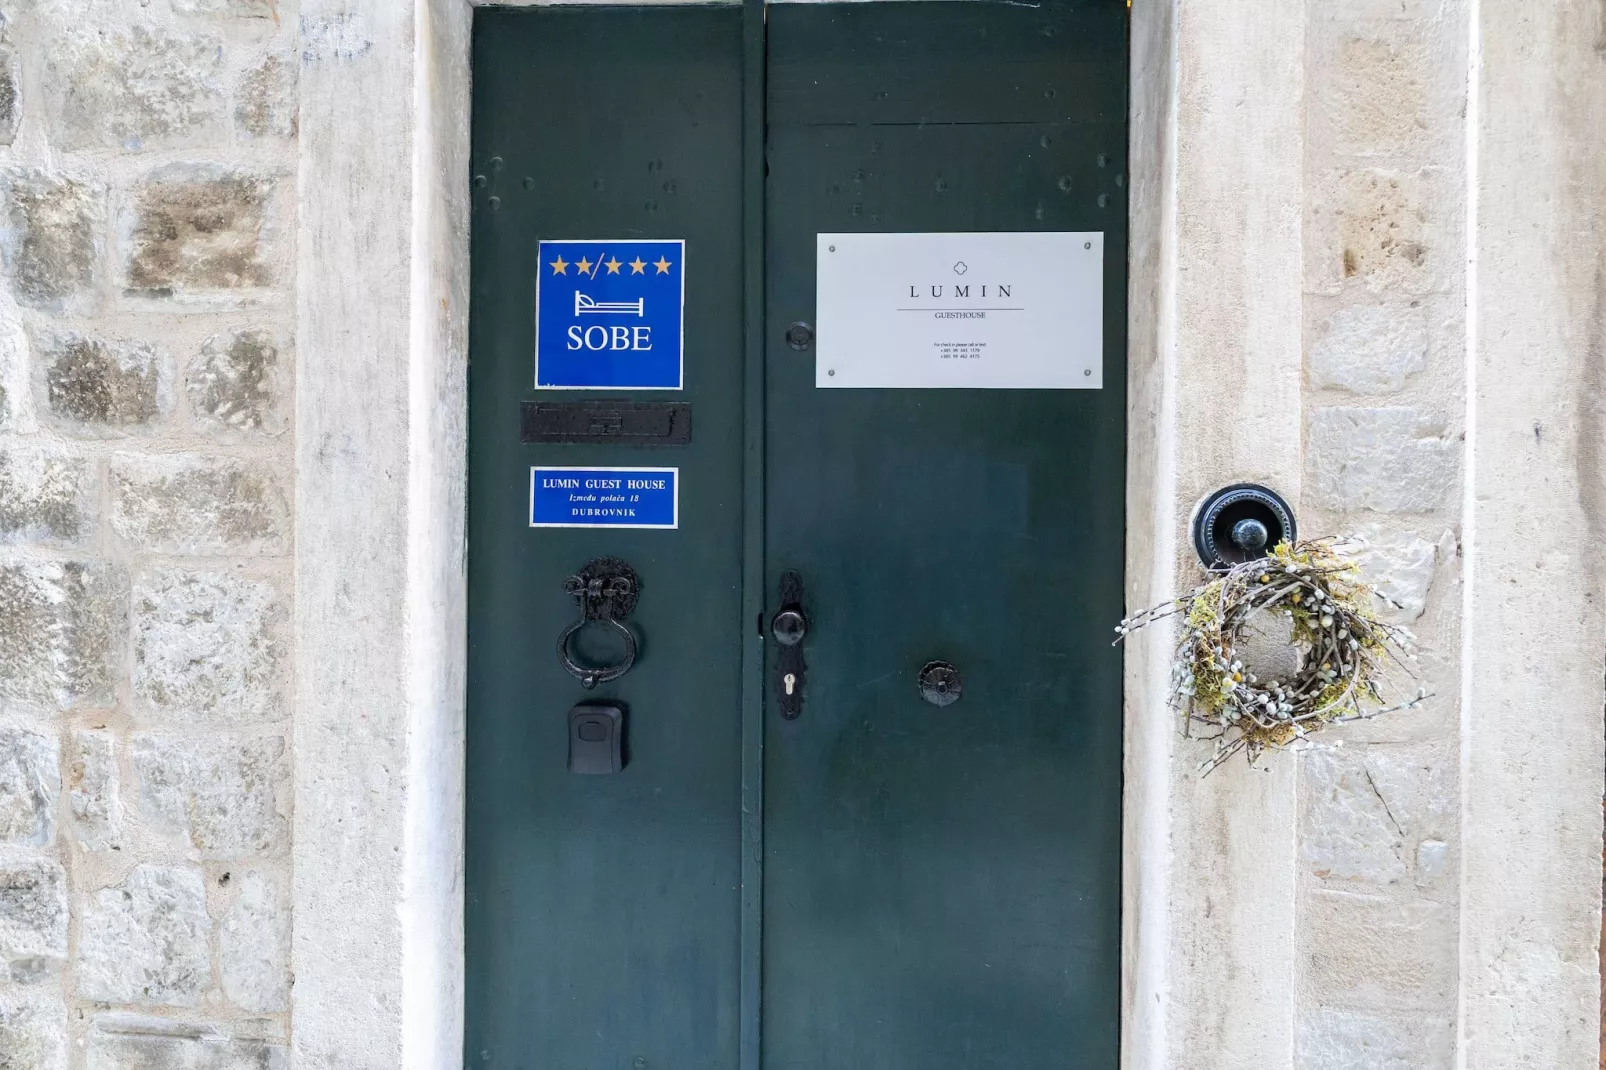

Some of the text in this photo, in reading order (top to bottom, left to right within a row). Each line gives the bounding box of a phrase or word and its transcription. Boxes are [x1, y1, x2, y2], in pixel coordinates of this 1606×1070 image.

[910, 285, 1012, 298] LUMIN
[567, 325, 652, 351] SOBE
[543, 479, 666, 490] LUMIN GUEST HOUSE
[572, 508, 636, 517] DUBROVNIK
